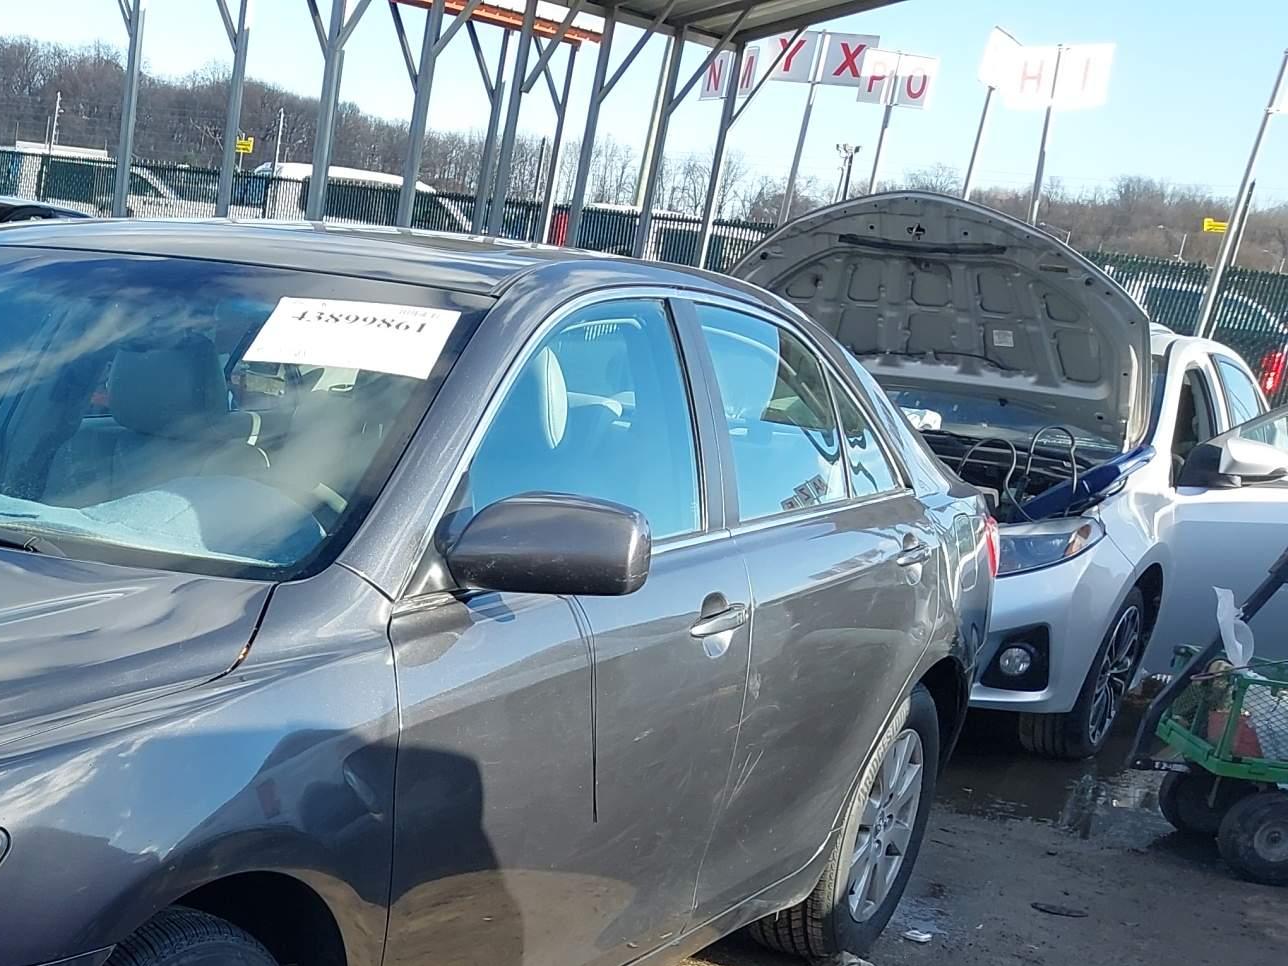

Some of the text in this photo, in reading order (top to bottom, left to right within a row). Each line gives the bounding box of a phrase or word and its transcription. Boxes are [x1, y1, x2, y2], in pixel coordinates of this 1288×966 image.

[779, 38, 807, 72] Y
[832, 42, 867, 78] X
[1019, 59, 1045, 94] H
[291, 310, 427, 333] 43899861
